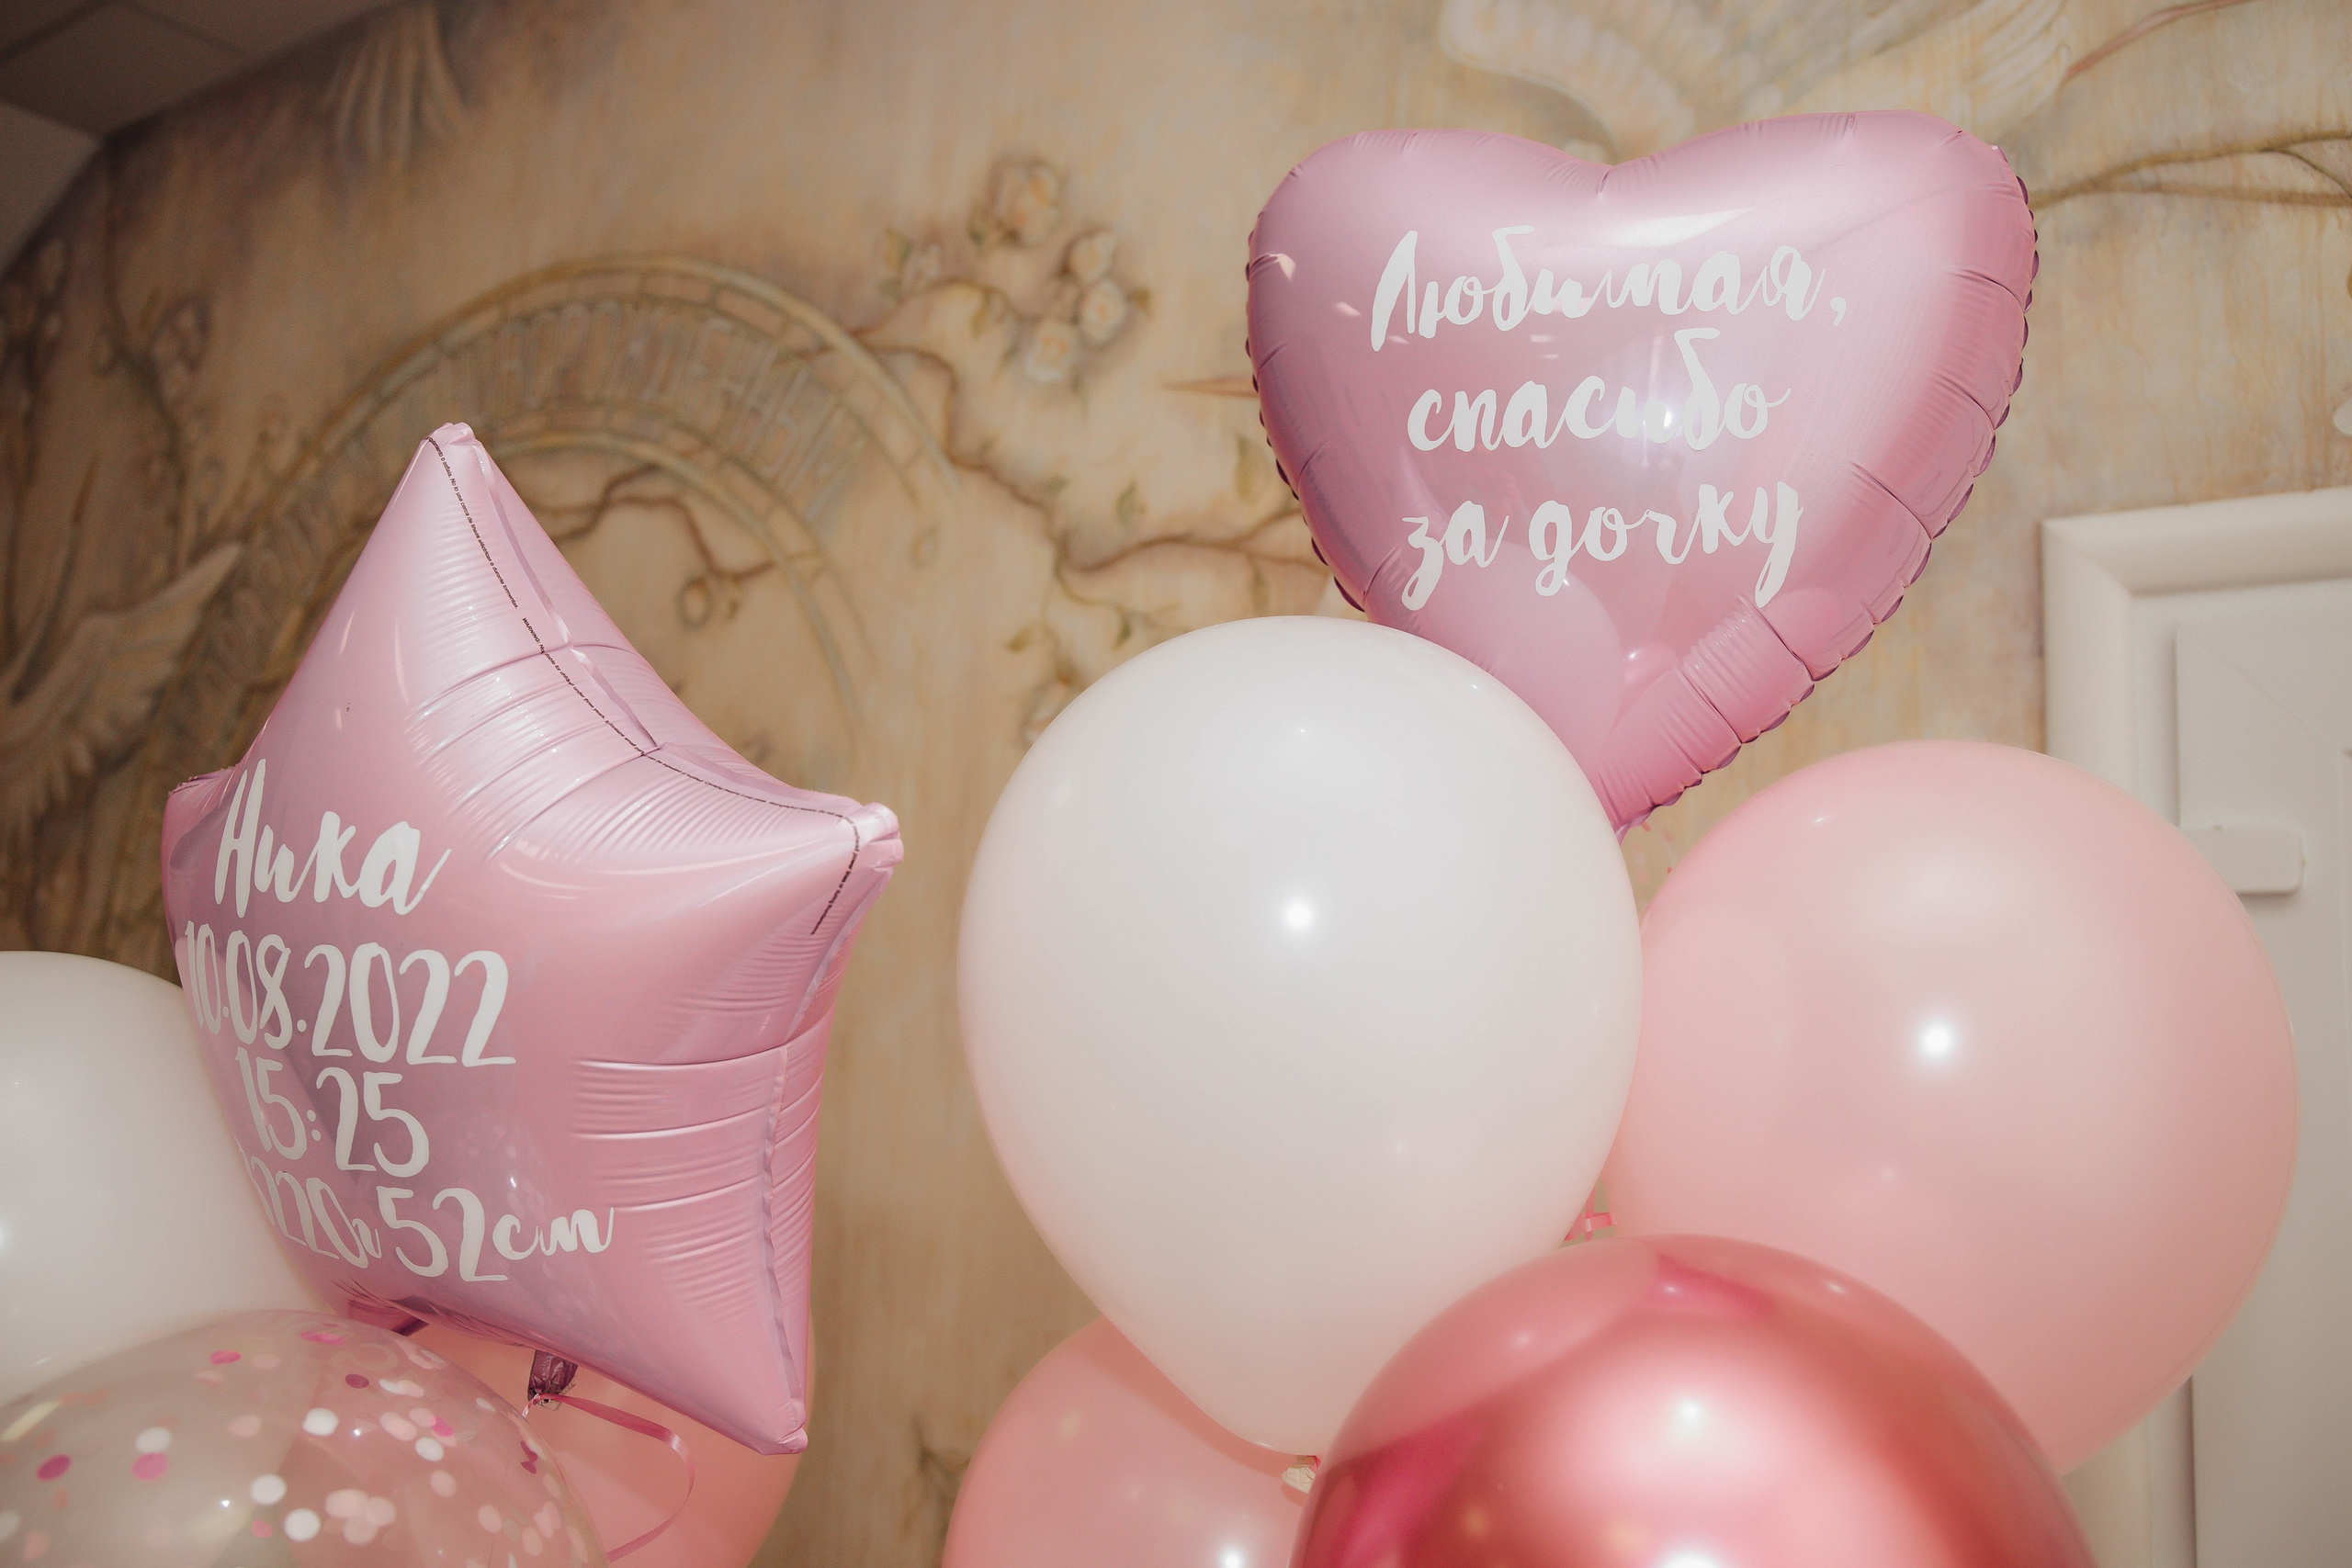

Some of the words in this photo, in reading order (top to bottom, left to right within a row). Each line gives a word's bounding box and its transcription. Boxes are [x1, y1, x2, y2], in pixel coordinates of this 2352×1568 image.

[1371, 224, 1847, 352] Любимая,
[1407, 326, 1792, 452] спасибо
[1401, 500, 1510, 612] за
[1528, 480, 1804, 608] дочку
[522, 616, 541, 644] WARNING:
[215, 758, 452, 919] Ника
[185, 919, 517, 1068] 10.08.2022
[235, 1046, 431, 1179] 15:25
